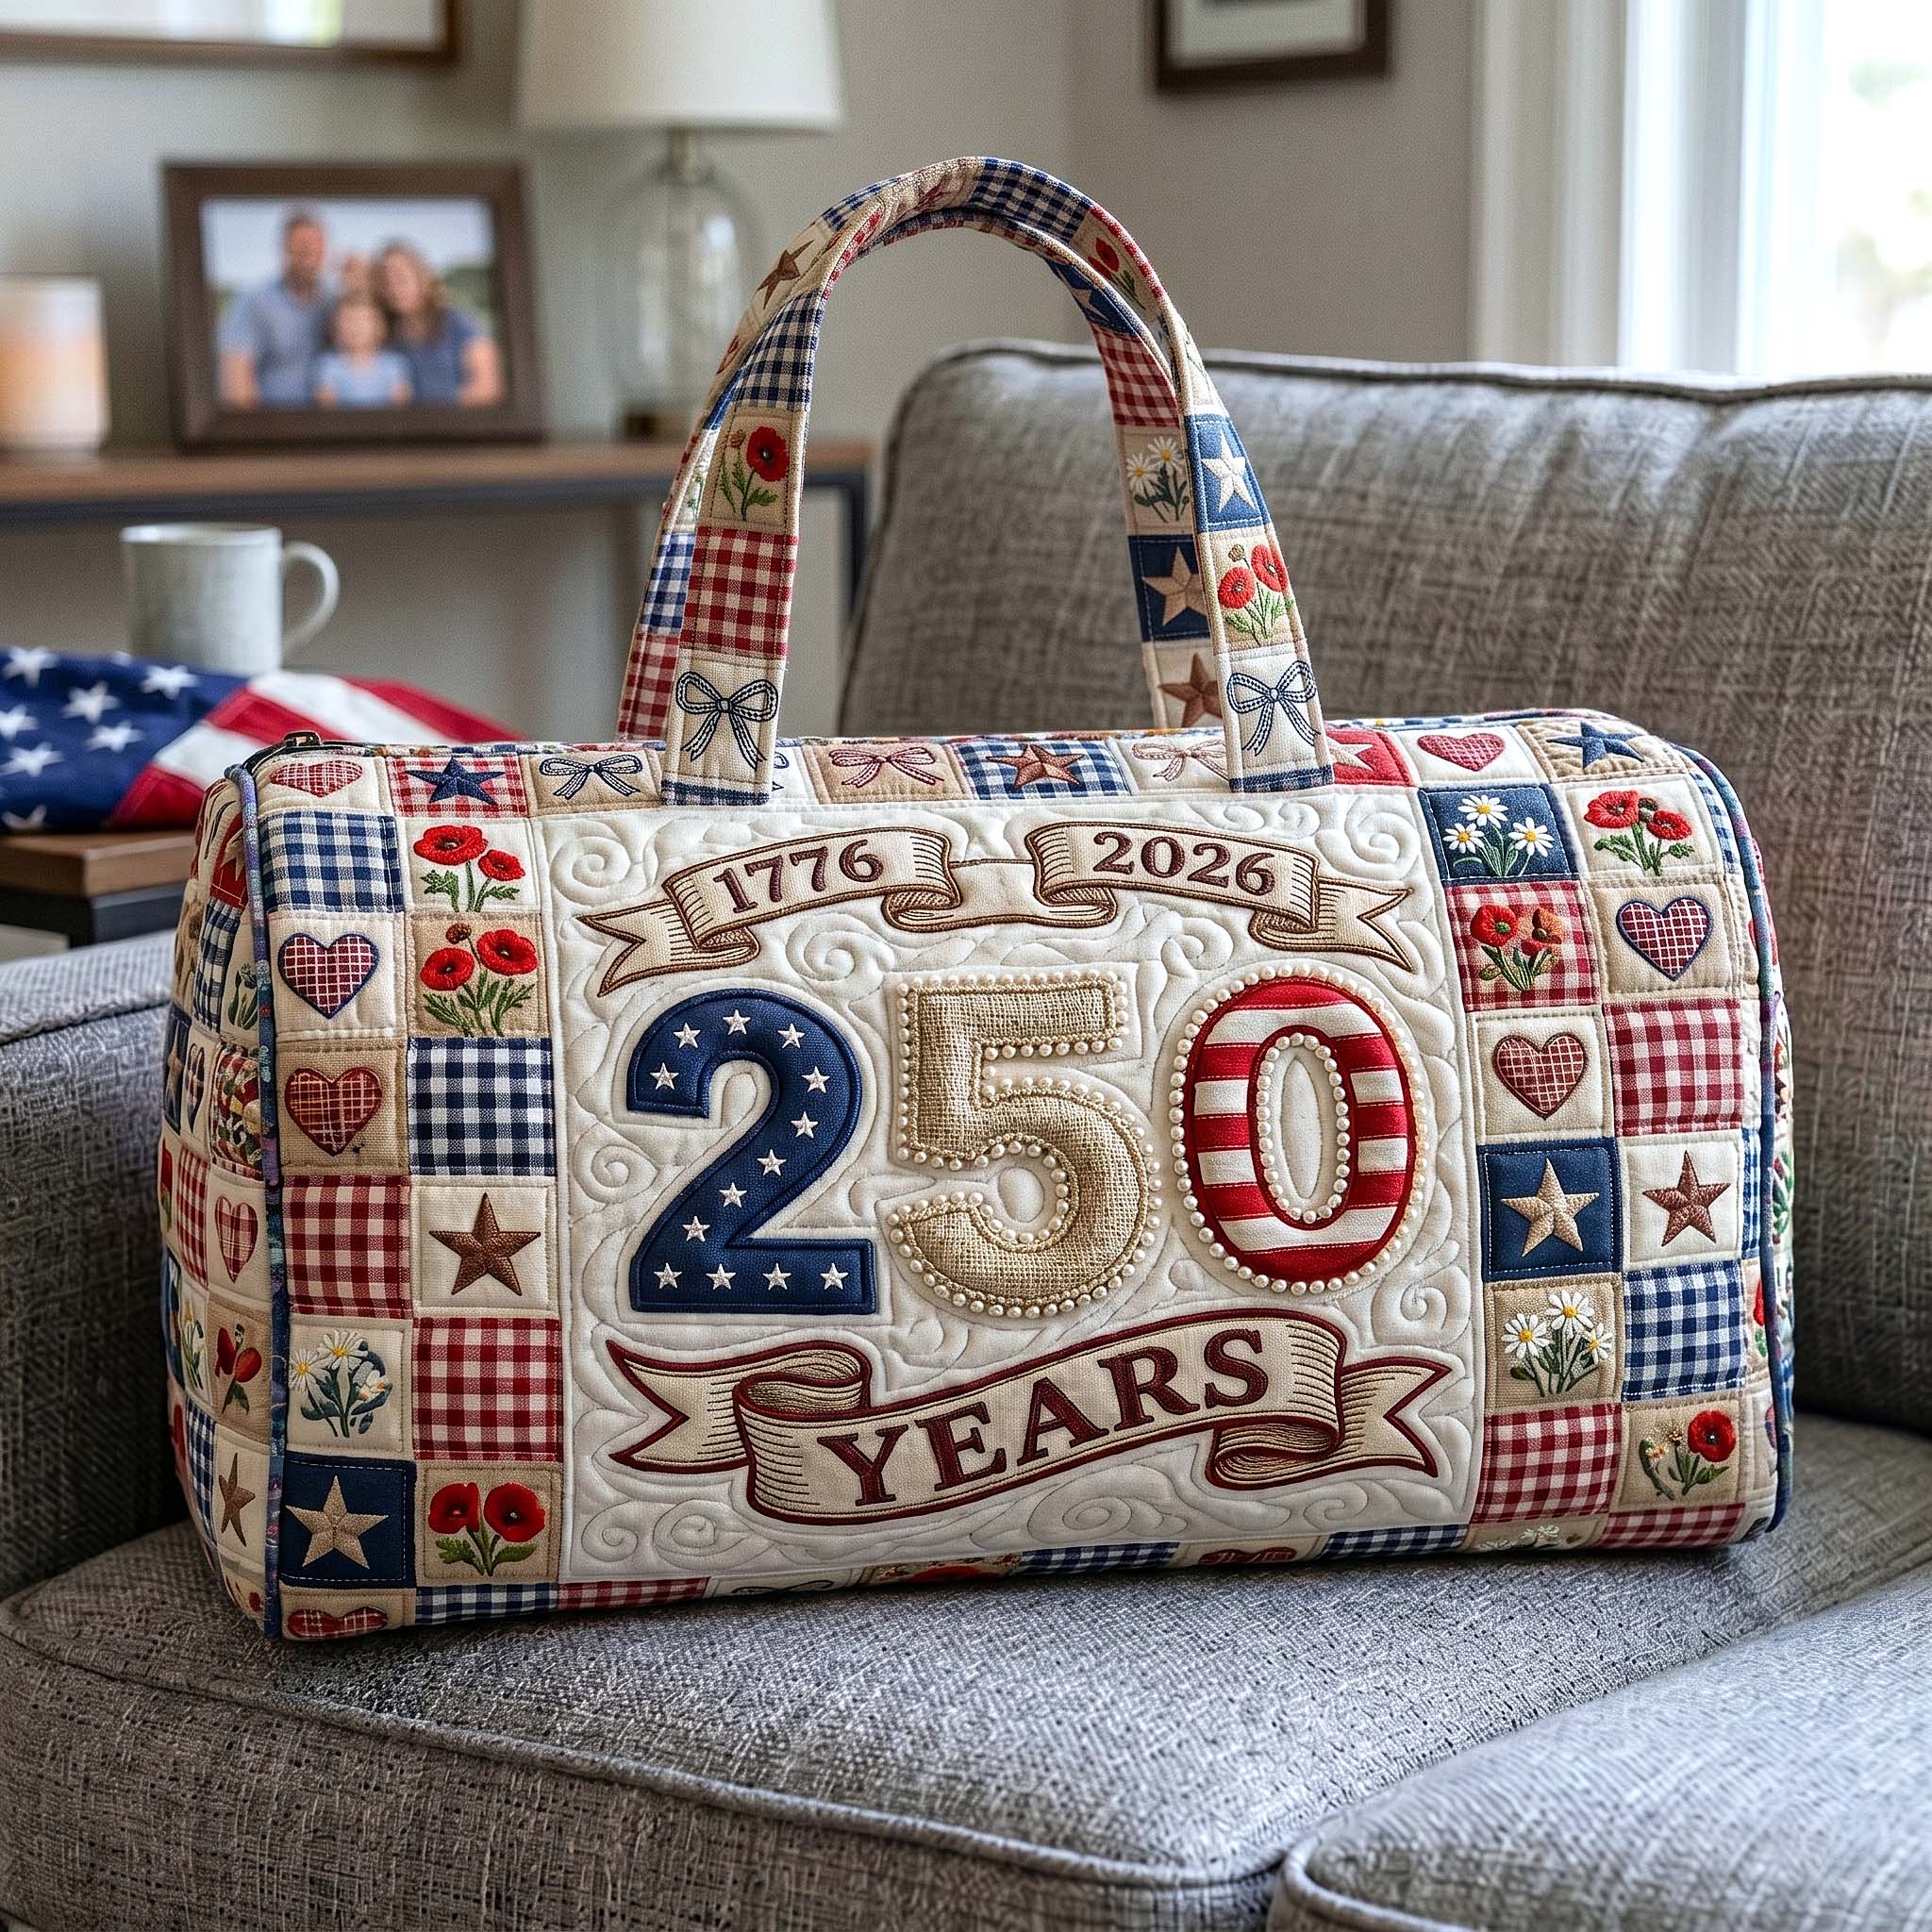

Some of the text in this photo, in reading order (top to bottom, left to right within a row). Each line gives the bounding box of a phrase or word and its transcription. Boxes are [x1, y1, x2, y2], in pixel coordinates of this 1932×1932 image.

[713, 839, 885, 913] 1776
[1092, 832, 1274, 896] 2026
[626, 969, 1425, 1318] 250
[818, 1328, 1269, 1507] YEARS
